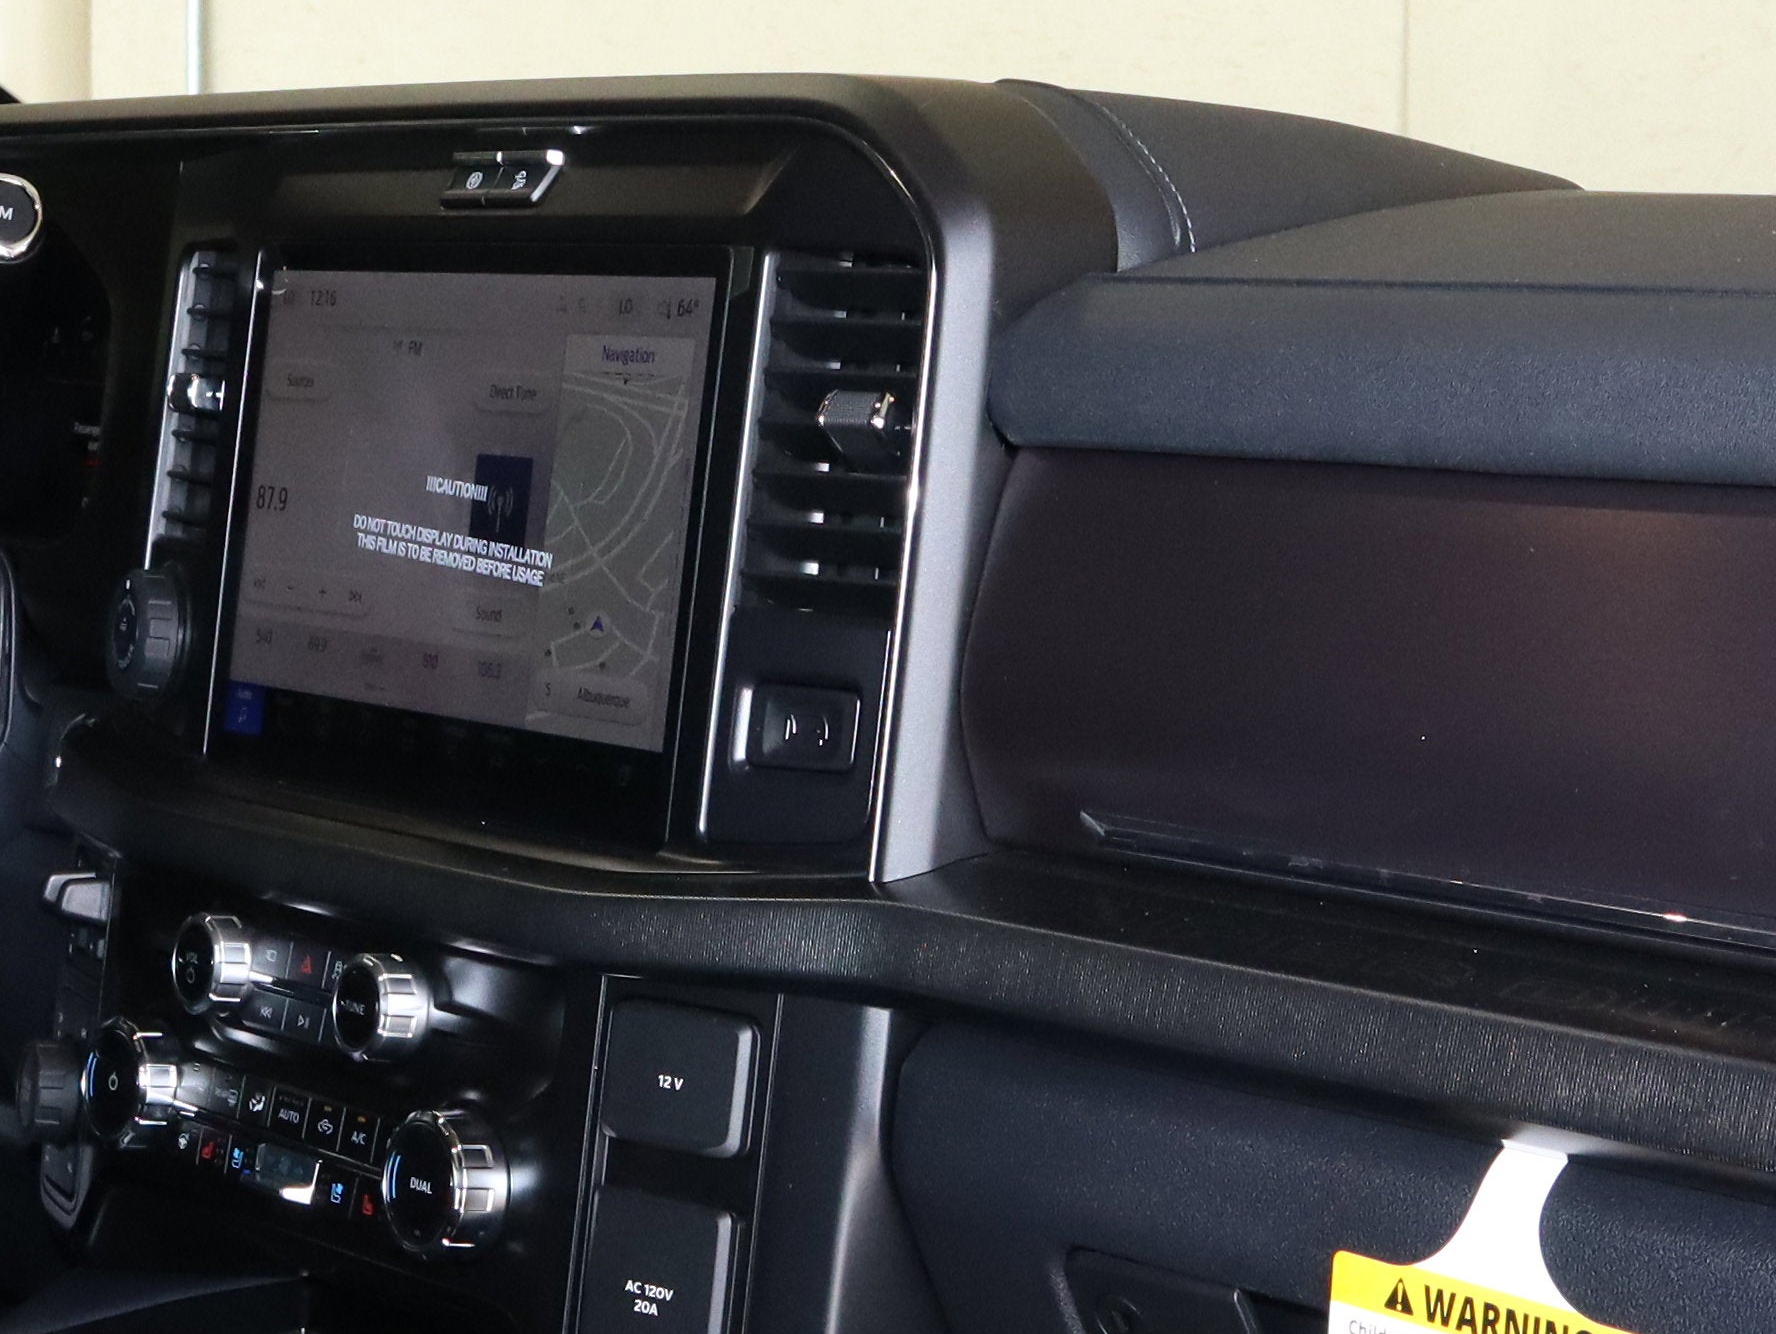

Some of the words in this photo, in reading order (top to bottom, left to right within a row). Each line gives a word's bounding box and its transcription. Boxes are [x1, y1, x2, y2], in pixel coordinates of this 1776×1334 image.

[601, 345, 655, 366] Navigation
[489, 384, 514, 400] Direct
[256, 486, 288, 512] 87.9
[353, 514, 367, 530] DO
[367, 516, 387, 533] NOT
[386, 520, 417, 541] TOUCH
[416, 527, 454, 548] DISPLAY
[453, 533, 488, 555] DURING
[488, 540, 554, 569] INSTALLATION
[356, 532, 376, 550] THIS
[376, 536, 397, 555] FILM
[397, 540, 407, 557] IS
[406, 542, 419, 560] TO
[419, 546, 432, 564] BE
[432, 548, 476, 573] REMOVED
[475, 558, 512, 580] BEFORE
[512, 564, 545, 587] USAGE
[577, 686, 630, 708] Albuquerque
[657, 1074, 672, 1089] 12
[673, 1077, 684, 1091] V
[278, 1108, 300, 1124] AUTO
[351, 1131, 367, 1147] A/C
[410, 1176, 433, 1195] DUAL
[625, 1279, 643, 1295] AC
[643, 1283, 674, 1302] 120V
[633, 1299, 659, 1317] 20A
